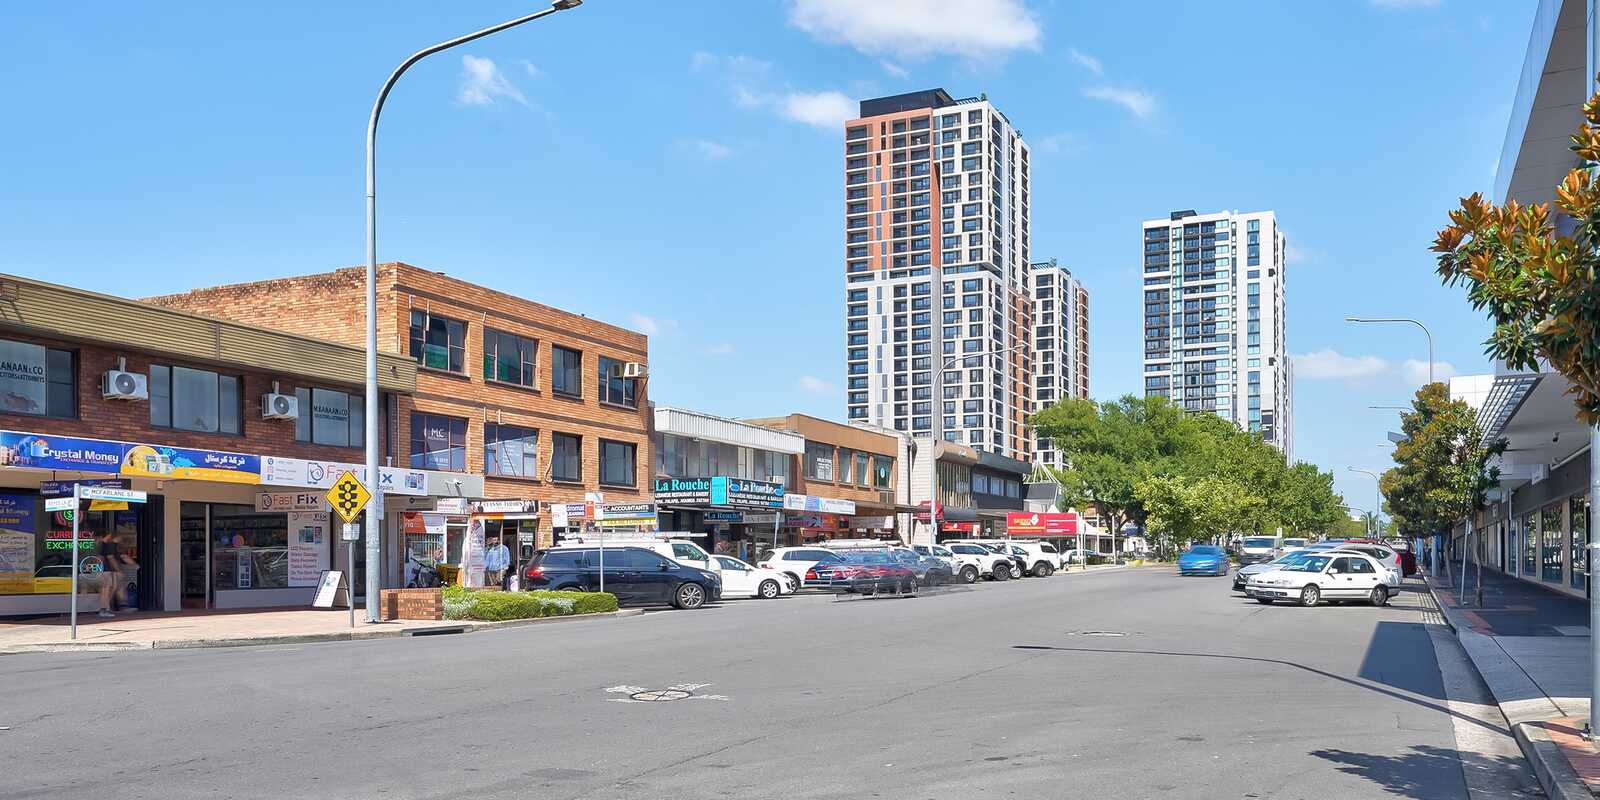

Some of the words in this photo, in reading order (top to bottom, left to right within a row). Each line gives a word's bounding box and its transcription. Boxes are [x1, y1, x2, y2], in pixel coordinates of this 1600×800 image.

[42, 447, 82, 460] Crystal
[85, 451, 118, 464] Money
[326, 464, 359, 481] Fat
[655, 480, 668, 493] La
[672, 478, 709, 493] Rouche
[740, 481, 750, 492] La
[273, 495, 293, 505] Fast
[297, 494, 318, 505] Fix
[611, 504, 650, 512] ACCOUNTANTS
[47, 530, 95, 539] CURRNCY
[47, 541, 95, 550] EXCHNGE
